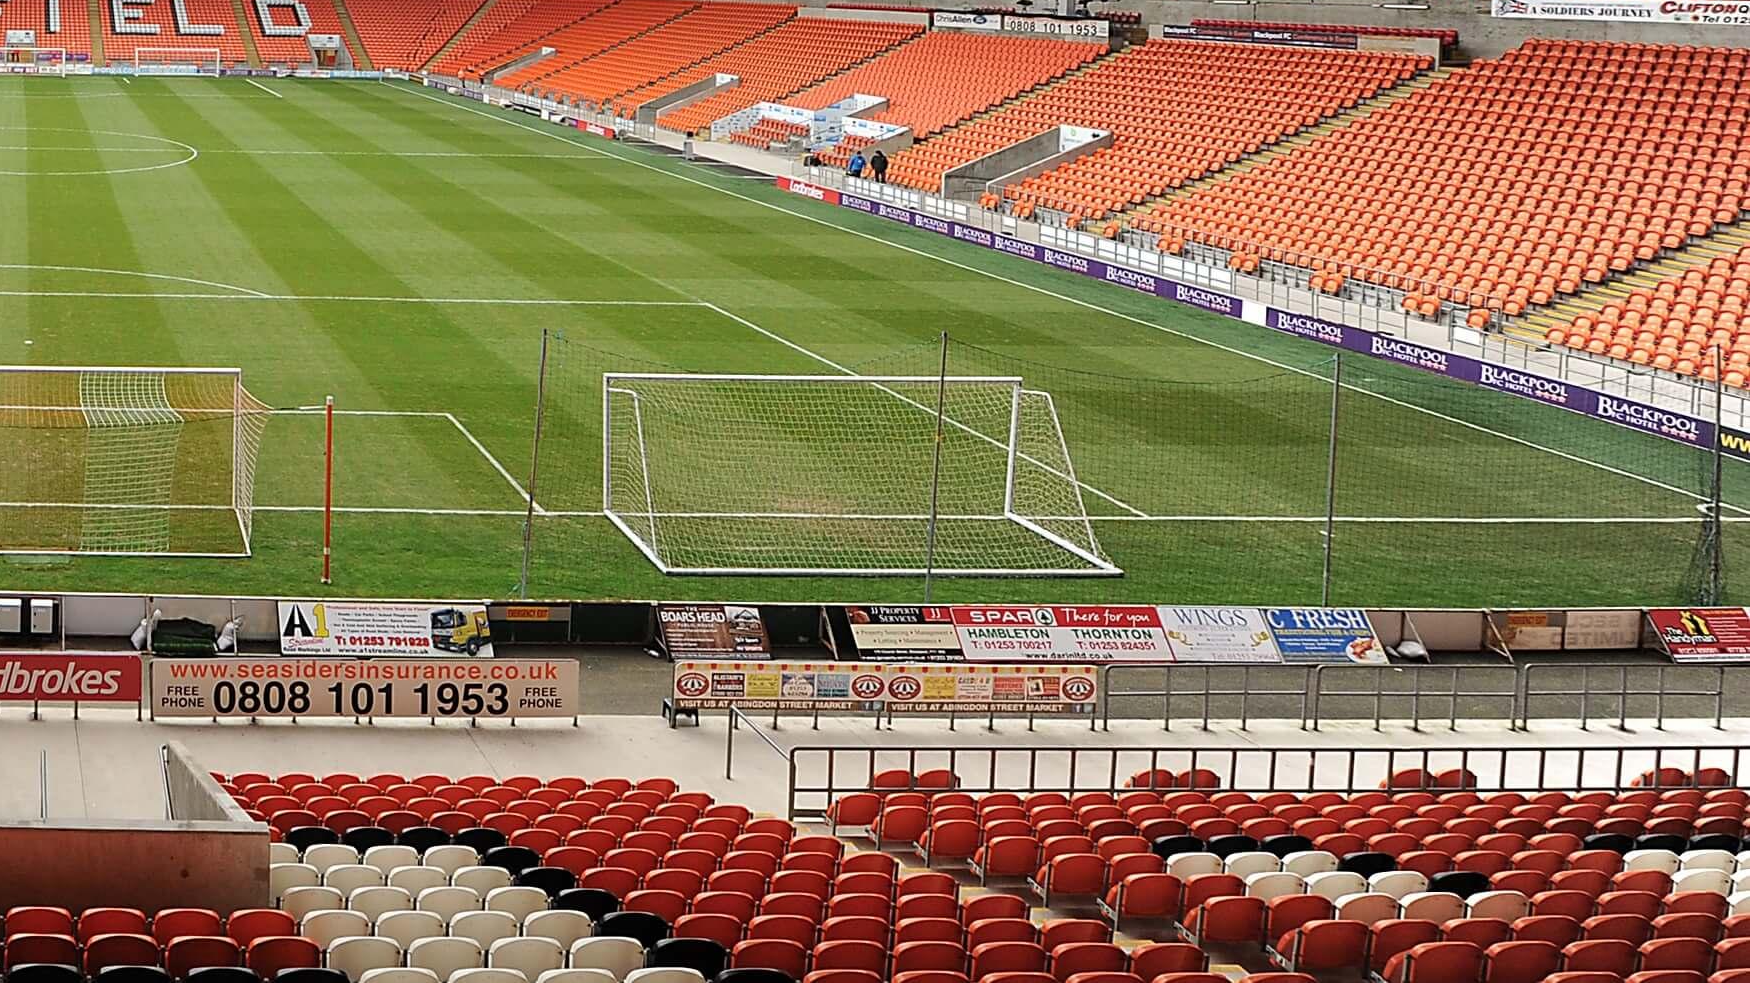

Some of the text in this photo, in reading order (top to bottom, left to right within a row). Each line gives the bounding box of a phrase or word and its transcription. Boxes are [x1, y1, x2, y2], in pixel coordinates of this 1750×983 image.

[1529, 6, 1654, 18] A SOLDIERS JOURNEY
[1010, 20, 1097, 36] 0808 101 1953
[1107, 266, 1156, 286] BLACKPOOL
[1176, 285, 1232, 307] BLACKPOOL
[1277, 312, 1343, 337] BLACKPOOL
[1372, 337, 1448, 365] BLACKPOOL
[1394, 351, 1418, 364] HOTEL
[1481, 364, 1568, 397] BLACKPOOL
[1505, 381, 1533, 396] HOTEL
[1598, 395, 1699, 434] BLACKPOOL
[1625, 414, 1659, 431] HOTEL
[661, 611, 726, 623] BOARS HEAD
[880, 607, 920, 615] PROPERTY
[931, 608, 941, 618] JJ
[970, 611, 1033, 622] SPAR
[1172, 608, 1248, 626] WINGS
[283, 604, 329, 638] A1
[1061, 608, 1150, 627] There for you
[1266, 610, 1366, 628] C FRESH
[968, 628, 1049, 639] HAMBLETON
[1072, 628, 1153, 639] THORNTON
[335, 636, 384, 645] T: 01253
[972, 641, 1052, 650] T: 01253 700217
[1077, 641, 1156, 650] T: 01253 824351
[170, 660, 558, 681] www.seasidersinsurance.co.uk
[167, 686, 200, 696] FREE
[525, 687, 558, 698] FREE
[162, 697, 205, 708] PHONE
[213, 681, 510, 716] 0808 101 1953
[519, 698, 563, 709] PHONE
[680, 700, 702, 708] VISIT
[731, 701, 778, 709] ABINGDON
[891, 703, 914, 711] VISIT
[1026, 704, 1064, 712] MARKET
